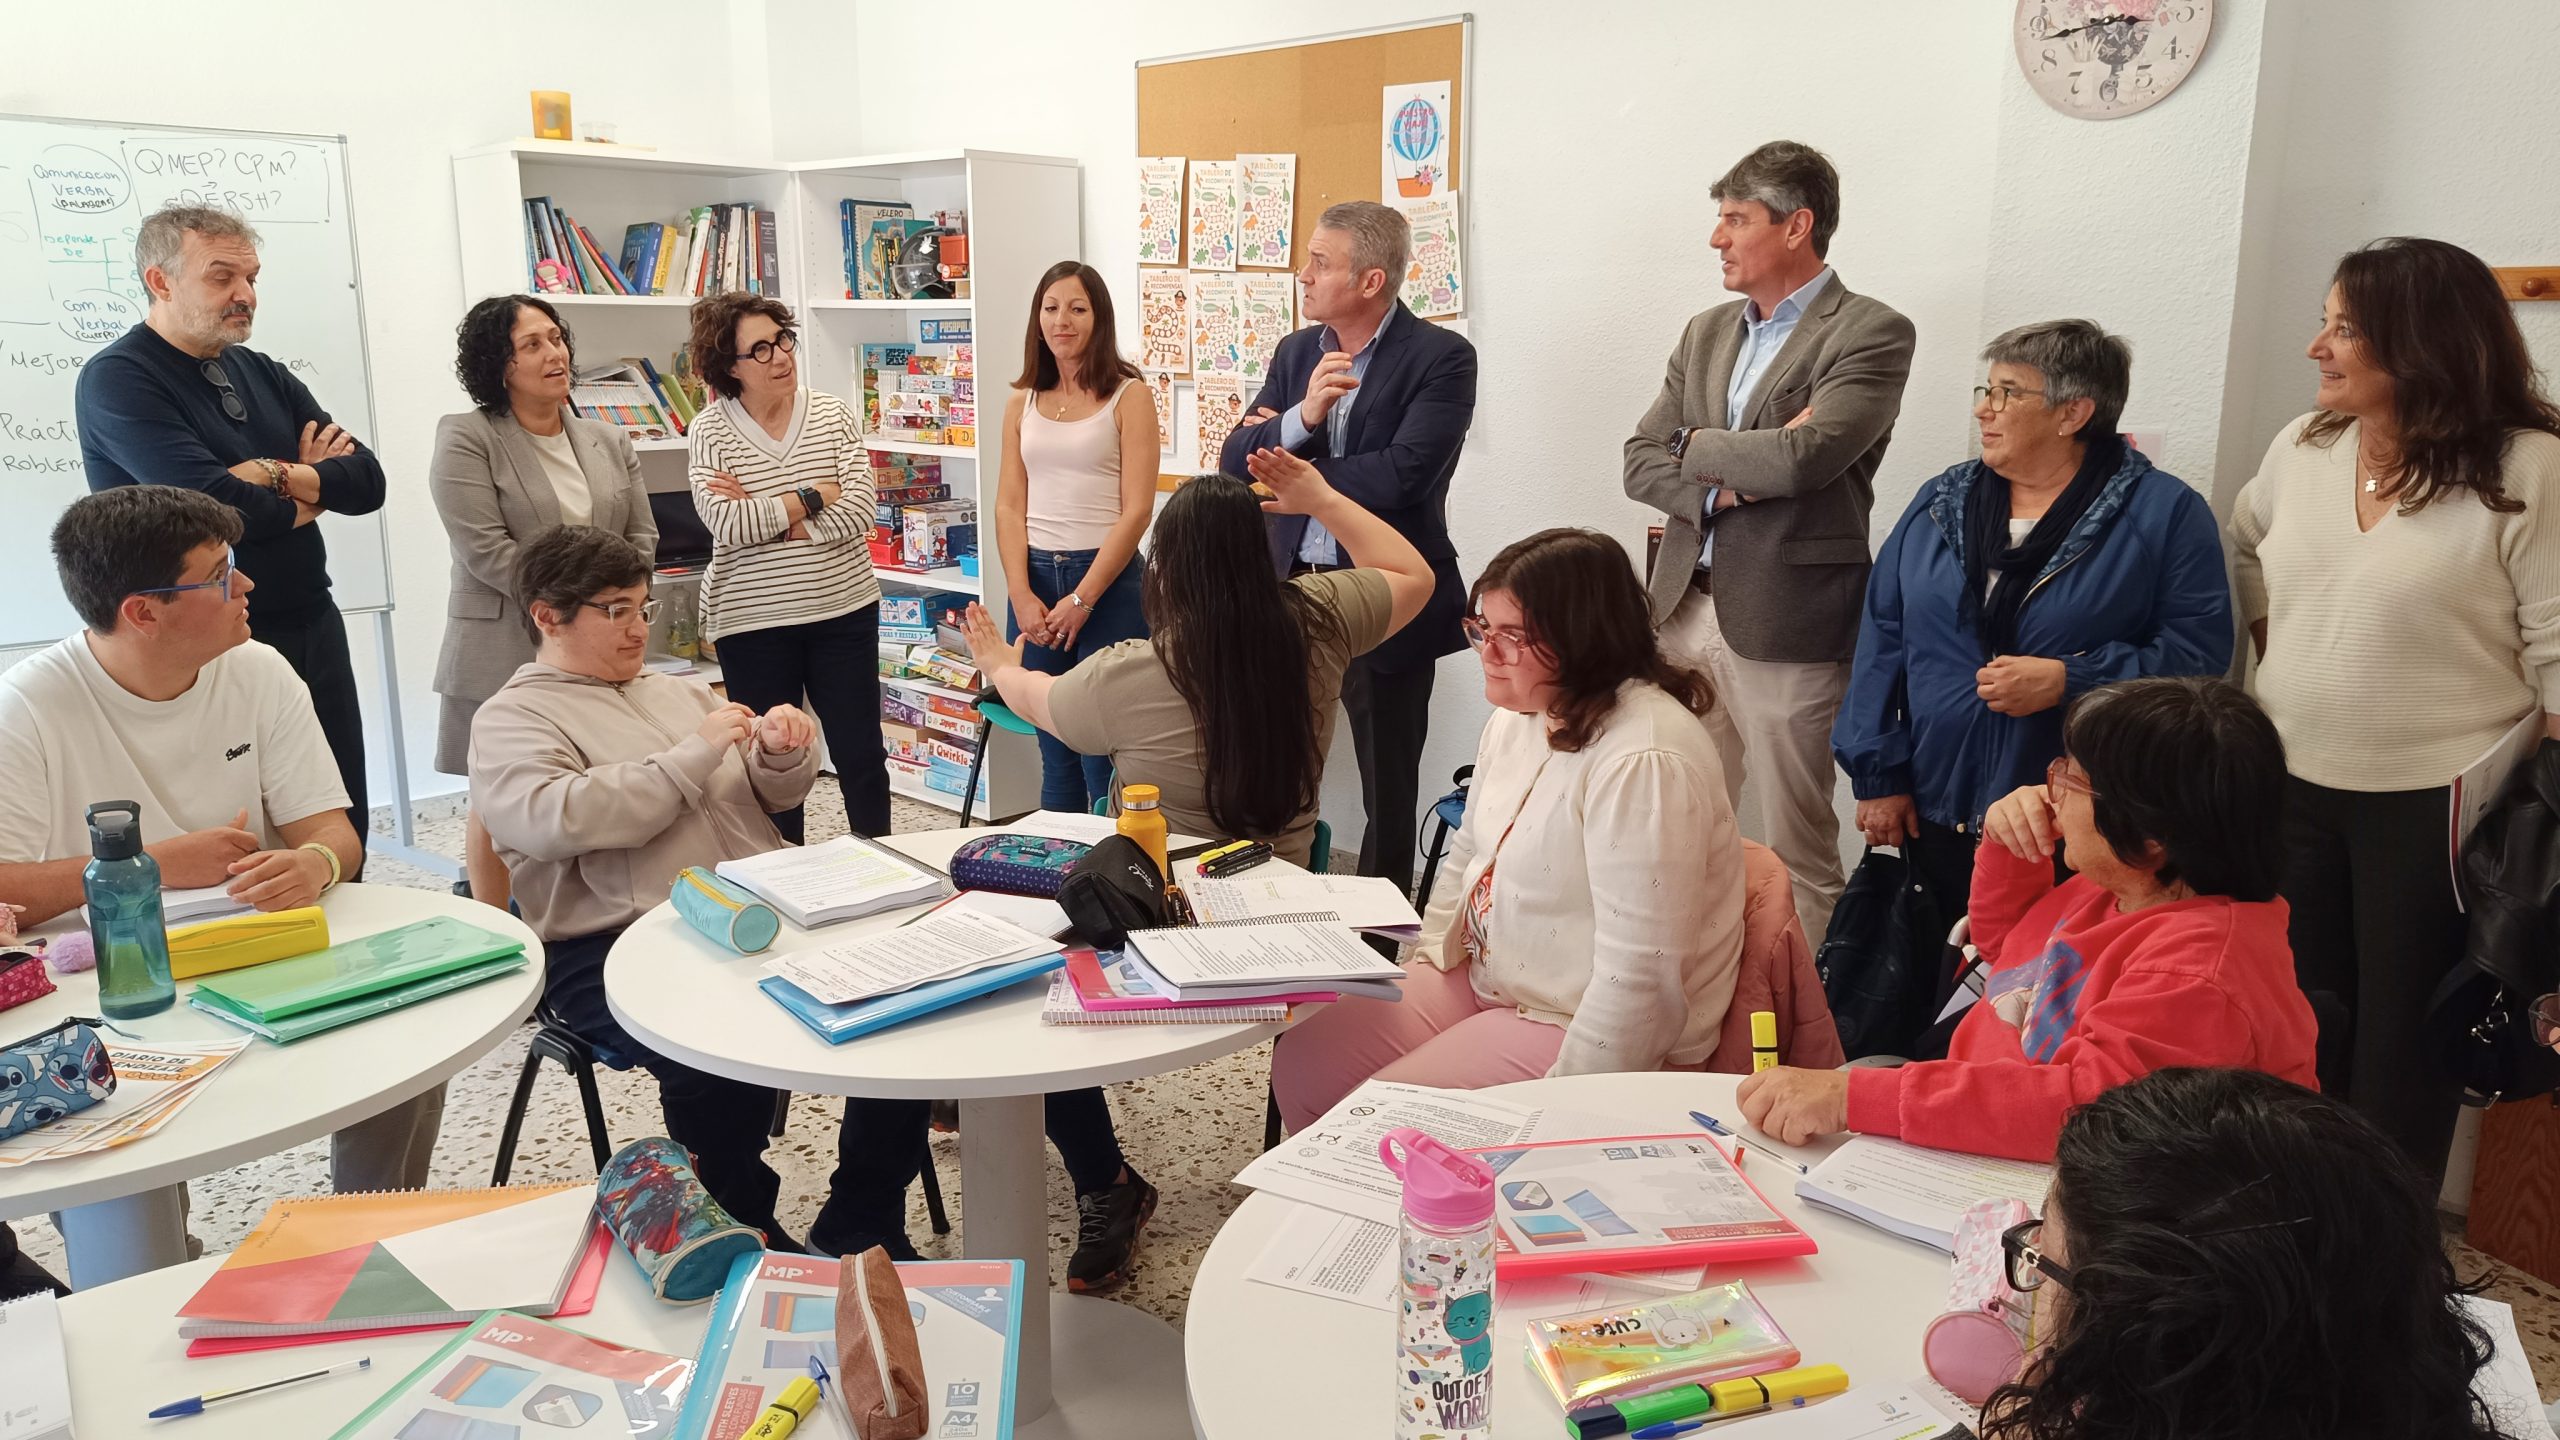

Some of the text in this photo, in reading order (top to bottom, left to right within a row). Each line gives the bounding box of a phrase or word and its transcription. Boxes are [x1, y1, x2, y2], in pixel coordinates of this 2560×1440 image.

[2029, 16, 2048, 40] 9
[2161, 35, 2182, 60] 4
[2041, 48, 2058, 73] 8
[2068, 71, 2083, 95] 7
[2135, 64, 2153, 89] 5
[2100, 79, 2119, 102] 6
[1225, 169, 1232, 177] DE
[937, 745, 968, 766] Qwirkle
[110, 1061, 189, 1072] ENDIZAJE
[111, 1052, 191, 1065] DIARIO DE
[1595, 1318, 1642, 1337] cute
[952, 1384, 976, 1395] 10
[1432, 1380, 1463, 1403] OUT
[1464, 1373, 1483, 1399] OF
[715, 1420, 728, 1440] WITH
[722, 1387, 739, 1418] SLEEVES
[948, 1414, 971, 1424] A4
